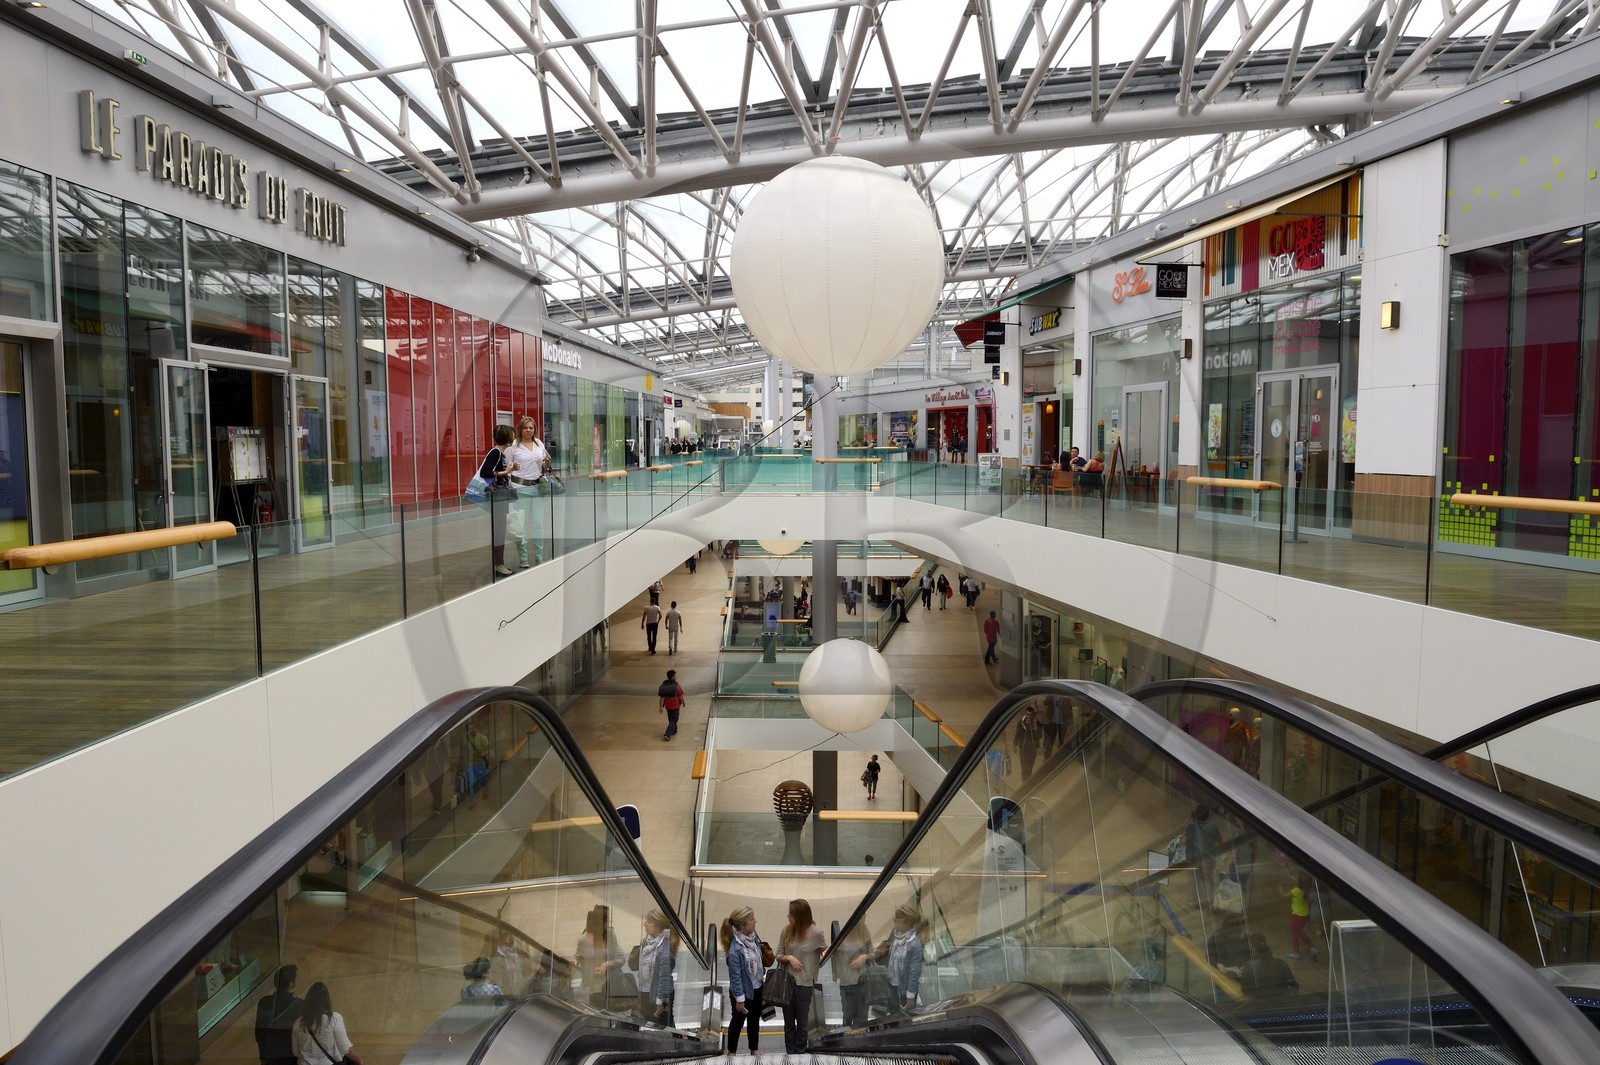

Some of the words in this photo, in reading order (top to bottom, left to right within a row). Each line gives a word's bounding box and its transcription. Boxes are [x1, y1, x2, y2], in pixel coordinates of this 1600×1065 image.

[79, 90, 122, 160] LE
[135, 115, 249, 209] PARADIS
[259, 170, 288, 225] DU
[297, 187, 348, 247] FRUIT
[1269, 220, 1296, 257] GO
[1159, 269, 1173, 281] GO
[1268, 251, 1296, 279] MEX
[1159, 280, 1173, 289] MEX
[1275, 295, 1323, 318] cuisine
[1029, 311, 1060, 334] SUBWAY
[541, 340, 582, 369] McDonald's
